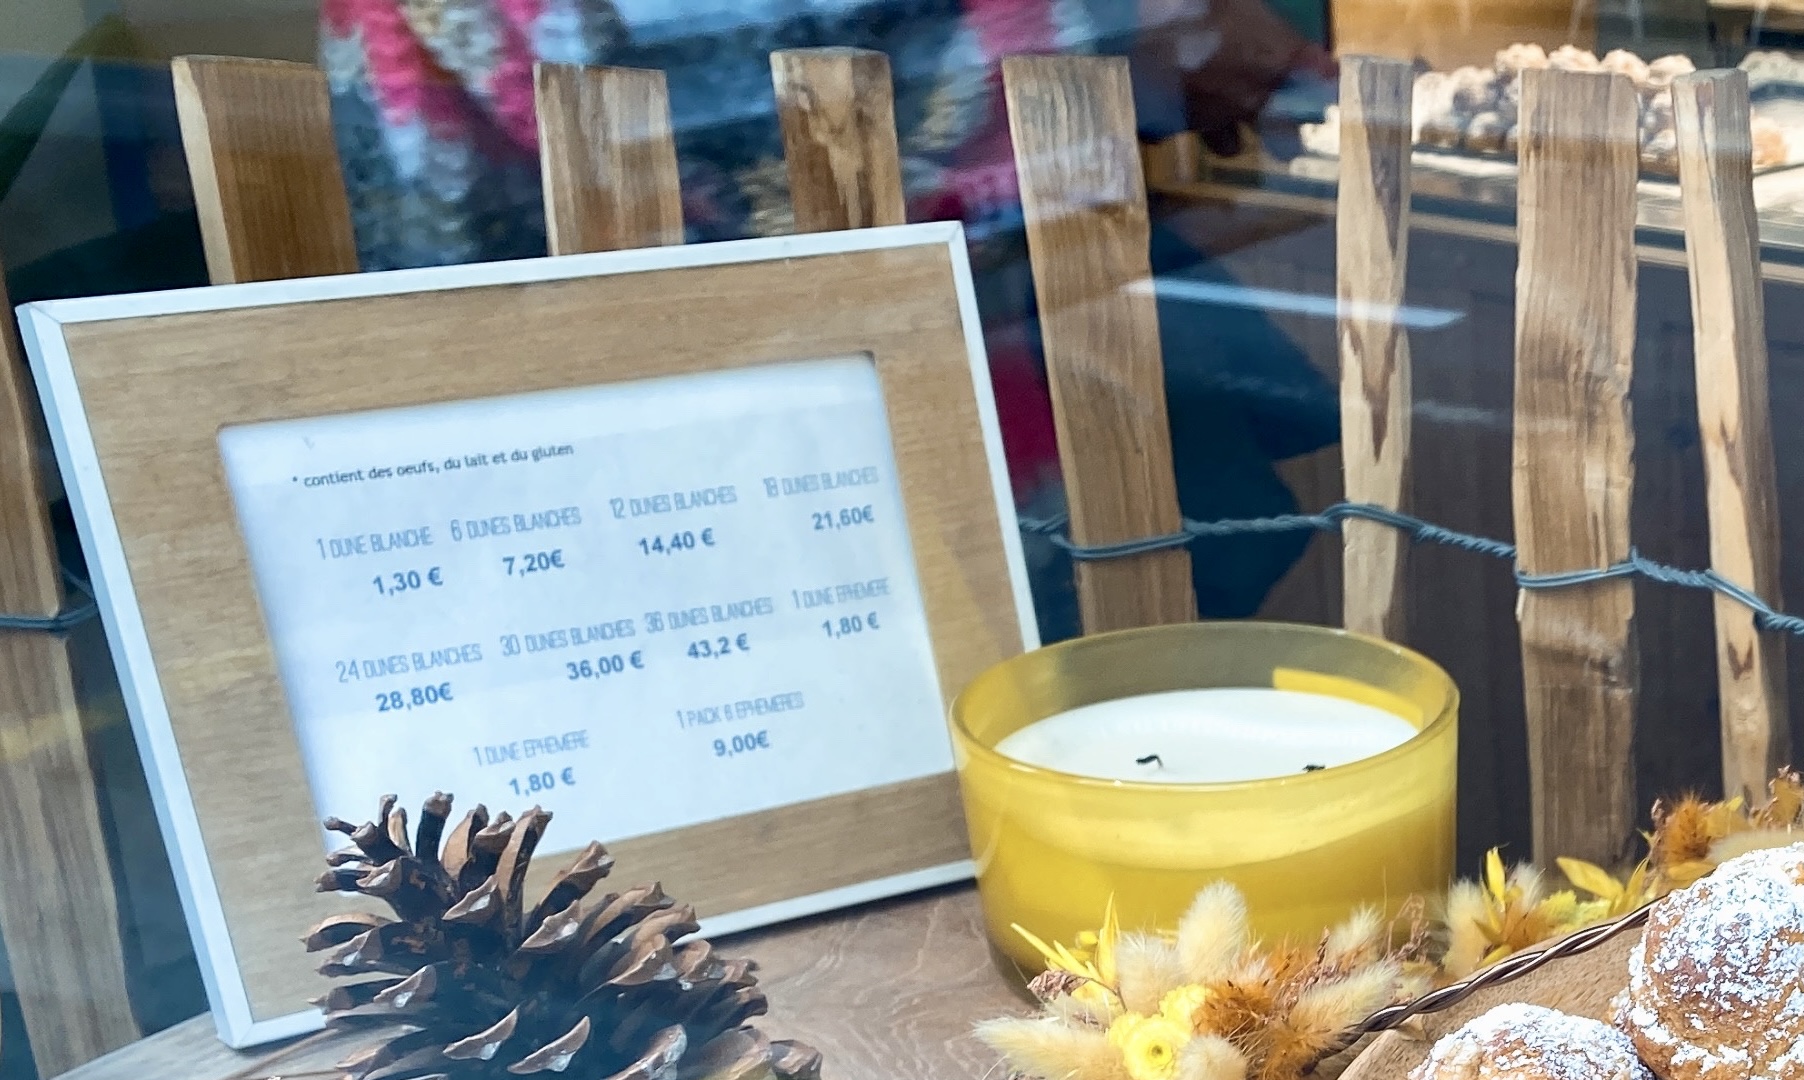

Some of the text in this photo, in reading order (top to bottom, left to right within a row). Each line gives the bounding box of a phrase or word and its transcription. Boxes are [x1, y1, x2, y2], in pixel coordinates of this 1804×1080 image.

[304, 470, 364, 488] contient
[368, 467, 392, 480] des
[396, 460, 440, 476] oeufs,
[443, 455, 461, 471] du
[464, 452, 489, 468] lait
[492, 450, 507, 464] et
[510, 448, 528, 462] du
[531, 444, 574, 463] gluten
[763, 466, 880, 498] 18 DUNES BLANCHES
[609, 485, 738, 519] 12 DUNES BLANCHES
[450, 506, 582, 542] 6 DUNES BLANCHES
[812, 505, 875, 531] 21,60€
[316, 526, 434, 560] 1 DUNE BLANCHE
[638, 527, 715, 556] 14,40 €
[502, 549, 565, 578] 7,20€
[372, 566, 444, 596] 1,30 €
[792, 589, 800, 610] 1
[803, 586, 835, 609] DUNE
[644, 597, 774, 634] 36 DUNES BLANCHES
[822, 611, 880, 639] 1,80 €
[500, 619, 636, 658] 30 DUNES BLANCHES
[687, 633, 750, 660] 43,2 €
[335, 642, 483, 684] 24 DUNES BLANCHES
[566, 650, 645, 681] 36,00 €
[375, 682, 454, 712] 28,80€
[676, 710, 686, 730] 1
[687, 706, 722, 727] PACK
[724, 704, 733, 722] 6
[473, 746, 483, 768] 1
[485, 741, 521, 765] DUNE
[713, 730, 770, 758] 9,00€
[509, 766, 576, 797] 1,80 €
